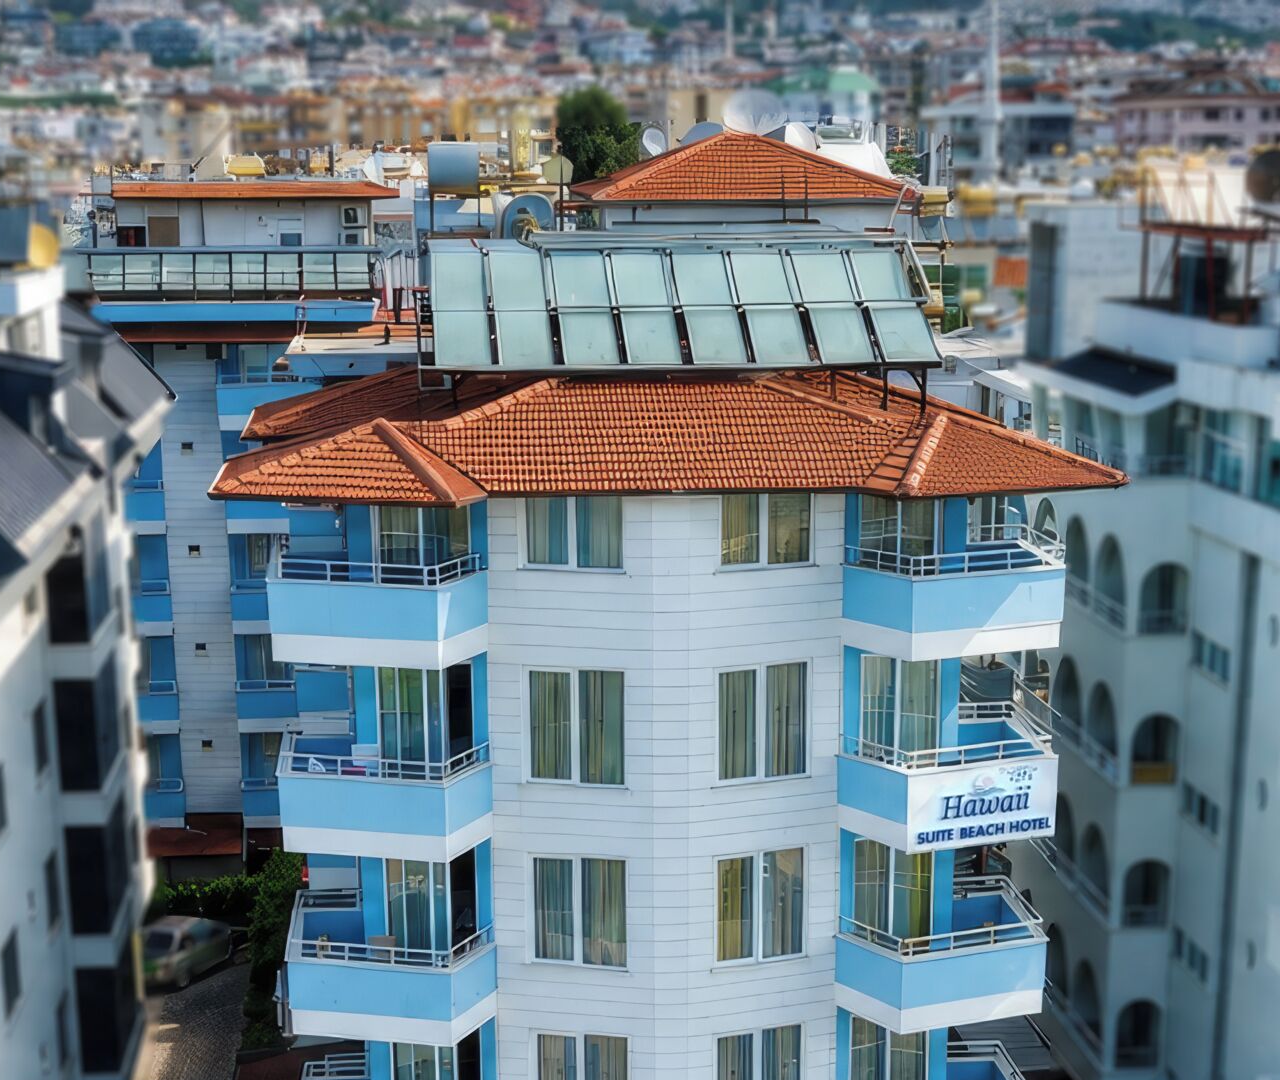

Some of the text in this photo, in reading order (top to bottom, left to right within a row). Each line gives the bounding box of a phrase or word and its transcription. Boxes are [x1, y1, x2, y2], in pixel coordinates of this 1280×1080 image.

[940, 791, 1031, 821] Hawaii
[916, 816, 1052, 845] SUITE BEACH HOTEL
